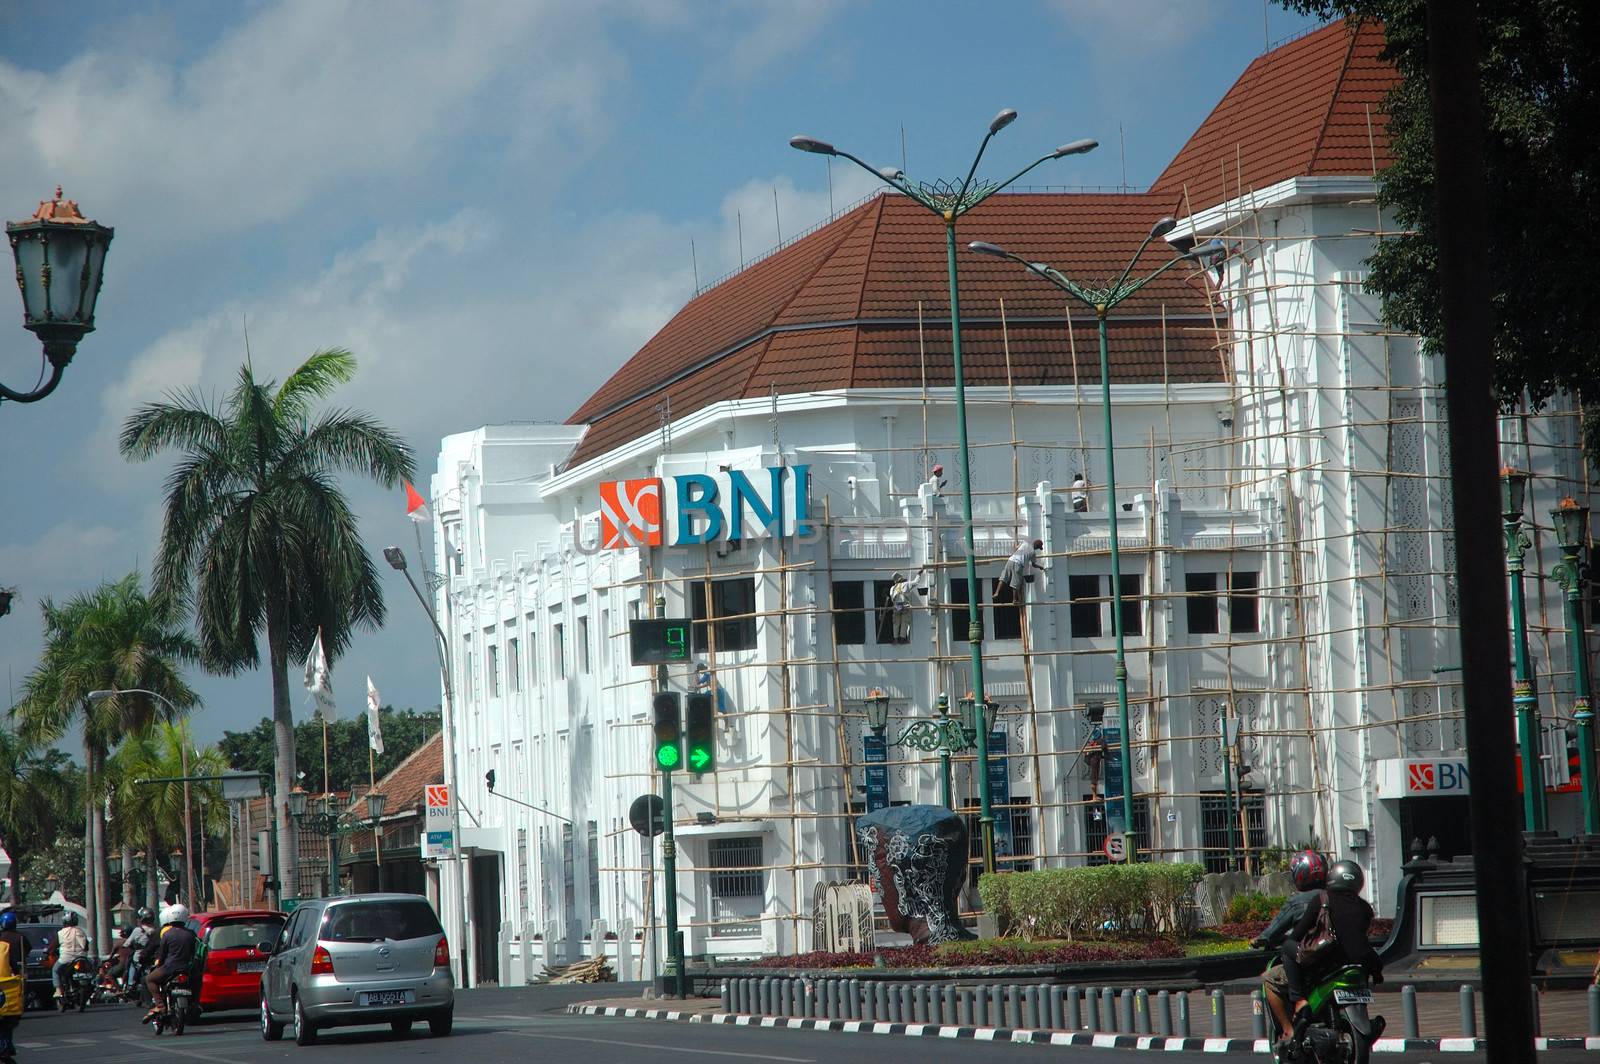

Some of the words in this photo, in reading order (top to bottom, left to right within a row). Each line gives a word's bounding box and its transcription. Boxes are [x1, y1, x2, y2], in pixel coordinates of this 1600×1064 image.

[673, 464, 810, 545] BNI
[667, 628, 685, 658] 9
[429, 807, 449, 817] BNI
